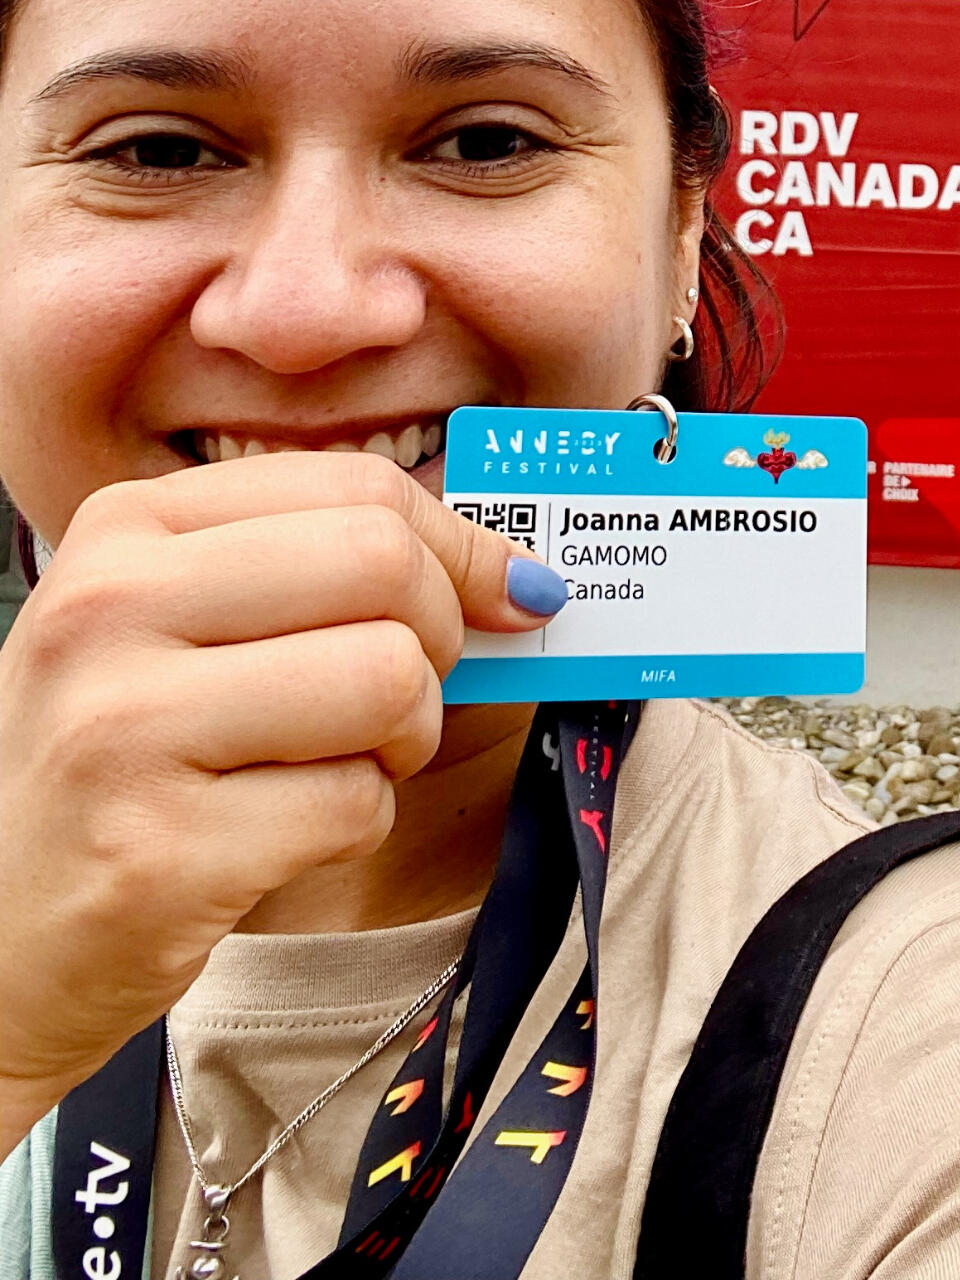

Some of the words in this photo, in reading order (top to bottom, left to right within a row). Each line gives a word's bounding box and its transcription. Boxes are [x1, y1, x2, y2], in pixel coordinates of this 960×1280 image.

[739, 110, 859, 156] RDV
[734, 209, 814, 256] CA
[485, 429, 621, 455] ANNECY
[484, 461, 614, 475] FESTIVAL
[560, 508, 659, 536] Joanna
[669, 509, 817, 532] AMBROSIO
[561, 545, 667, 566] GAMOMO
[641, 670, 676, 682] MIFA
